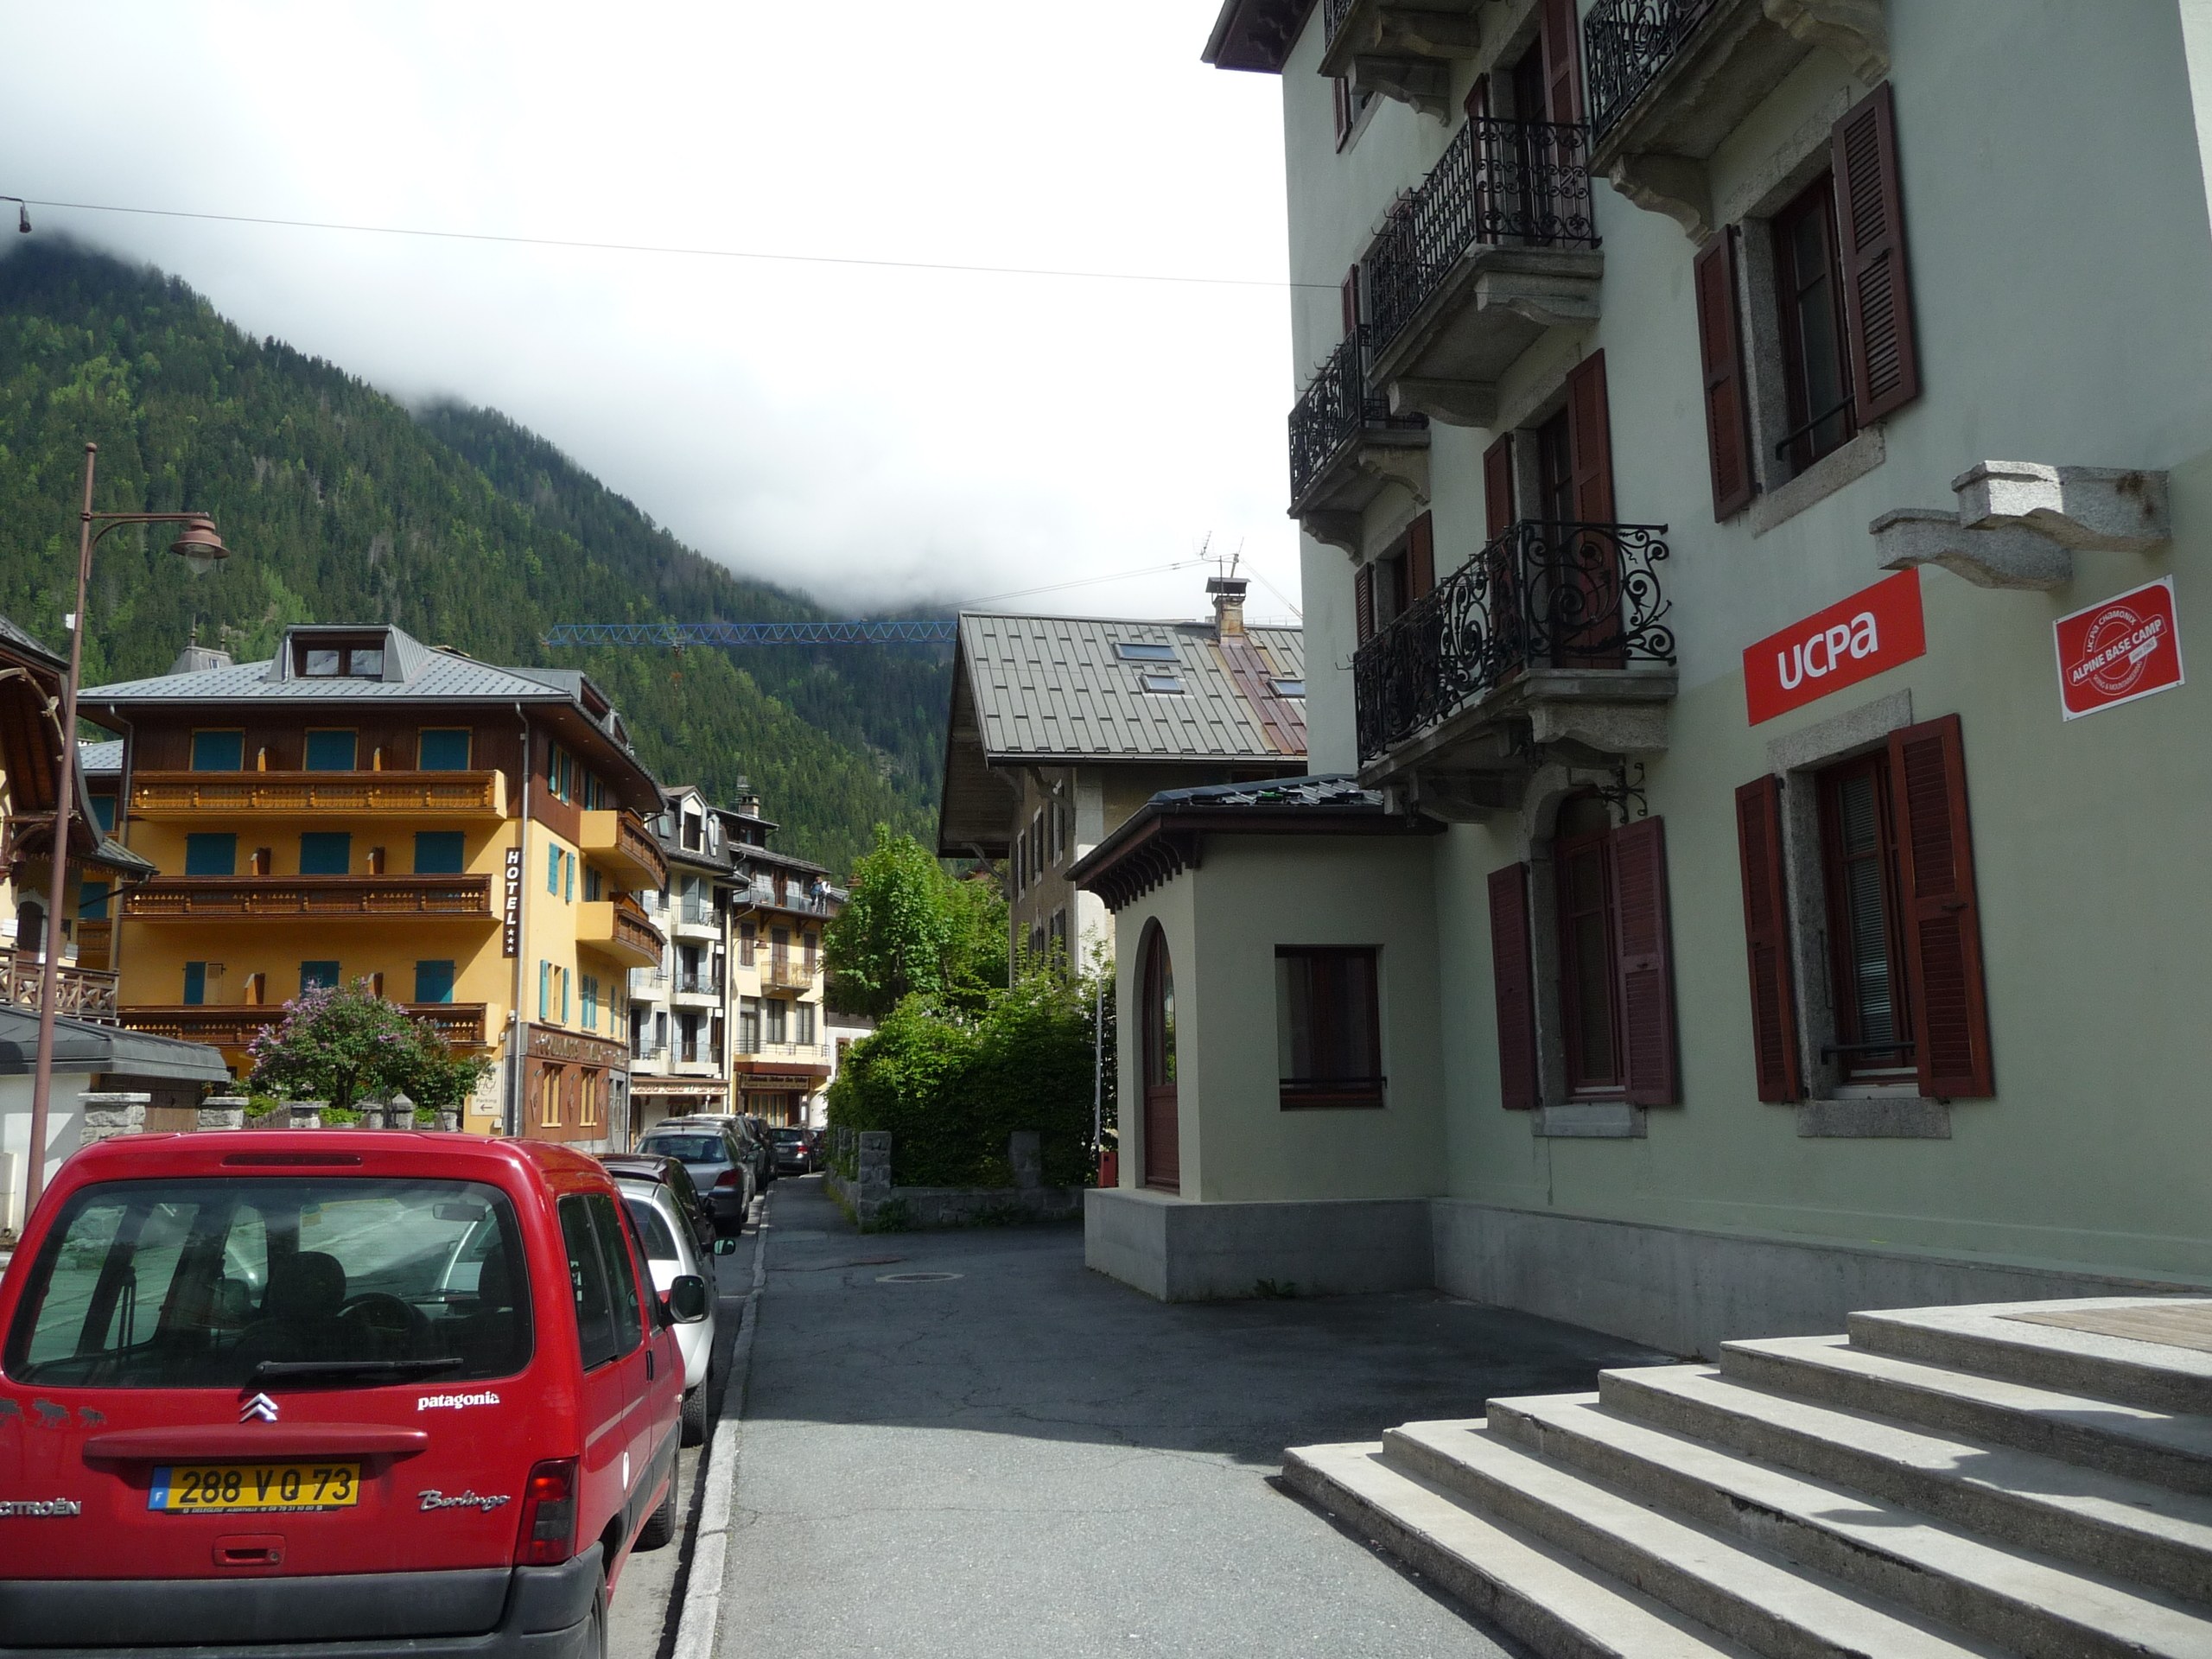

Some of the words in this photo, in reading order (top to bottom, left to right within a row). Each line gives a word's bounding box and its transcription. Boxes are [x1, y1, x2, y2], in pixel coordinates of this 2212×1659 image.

[2073, 653, 2106, 683] ALPINE
[2105, 639, 2132, 662] BASE
[2132, 619, 2163, 645] CAMP
[505, 851, 519, 925] HOTEL
[417, 1391, 500, 1410] patagonia
[179, 1471, 242, 1503] 288
[312, 1468, 353, 1501] 73
[0, 1497, 81, 1516] CITROËN
[155, 1492, 162, 1502] F
[418, 1490, 511, 1511] Berlingo
